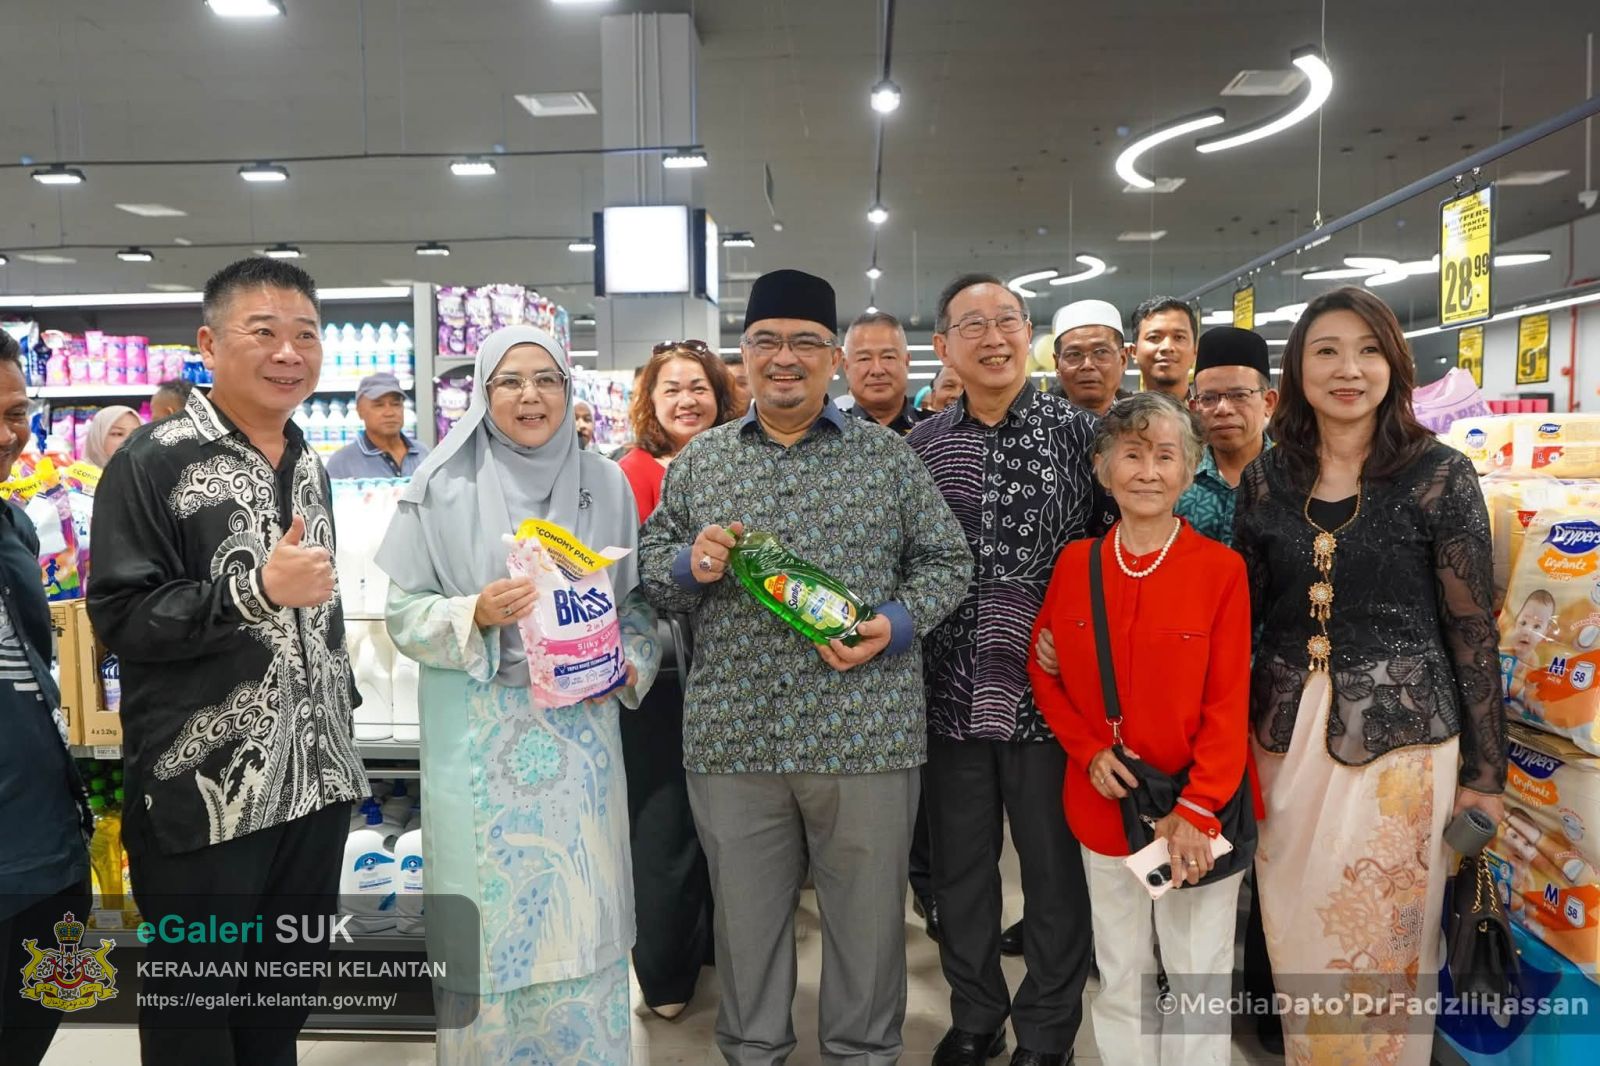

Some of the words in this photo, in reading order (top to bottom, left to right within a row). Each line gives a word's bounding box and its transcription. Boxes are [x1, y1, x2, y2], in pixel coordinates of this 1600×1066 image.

[1444, 256, 1473, 314] 28
[1474, 253, 1489, 278] 99
[1521, 347, 1537, 377] 9
[1551, 525, 1600, 546] Drypers
[573, 549, 596, 567] PACK
[586, 624, 593, 632] 2
[577, 640, 599, 651] Silky
[1549, 656, 1567, 676] M
[1573, 671, 1586, 683] 58
[1511, 743, 1556, 771] Drypers
[1545, 883, 1559, 905] M
[1567, 905, 1579, 919] 58
